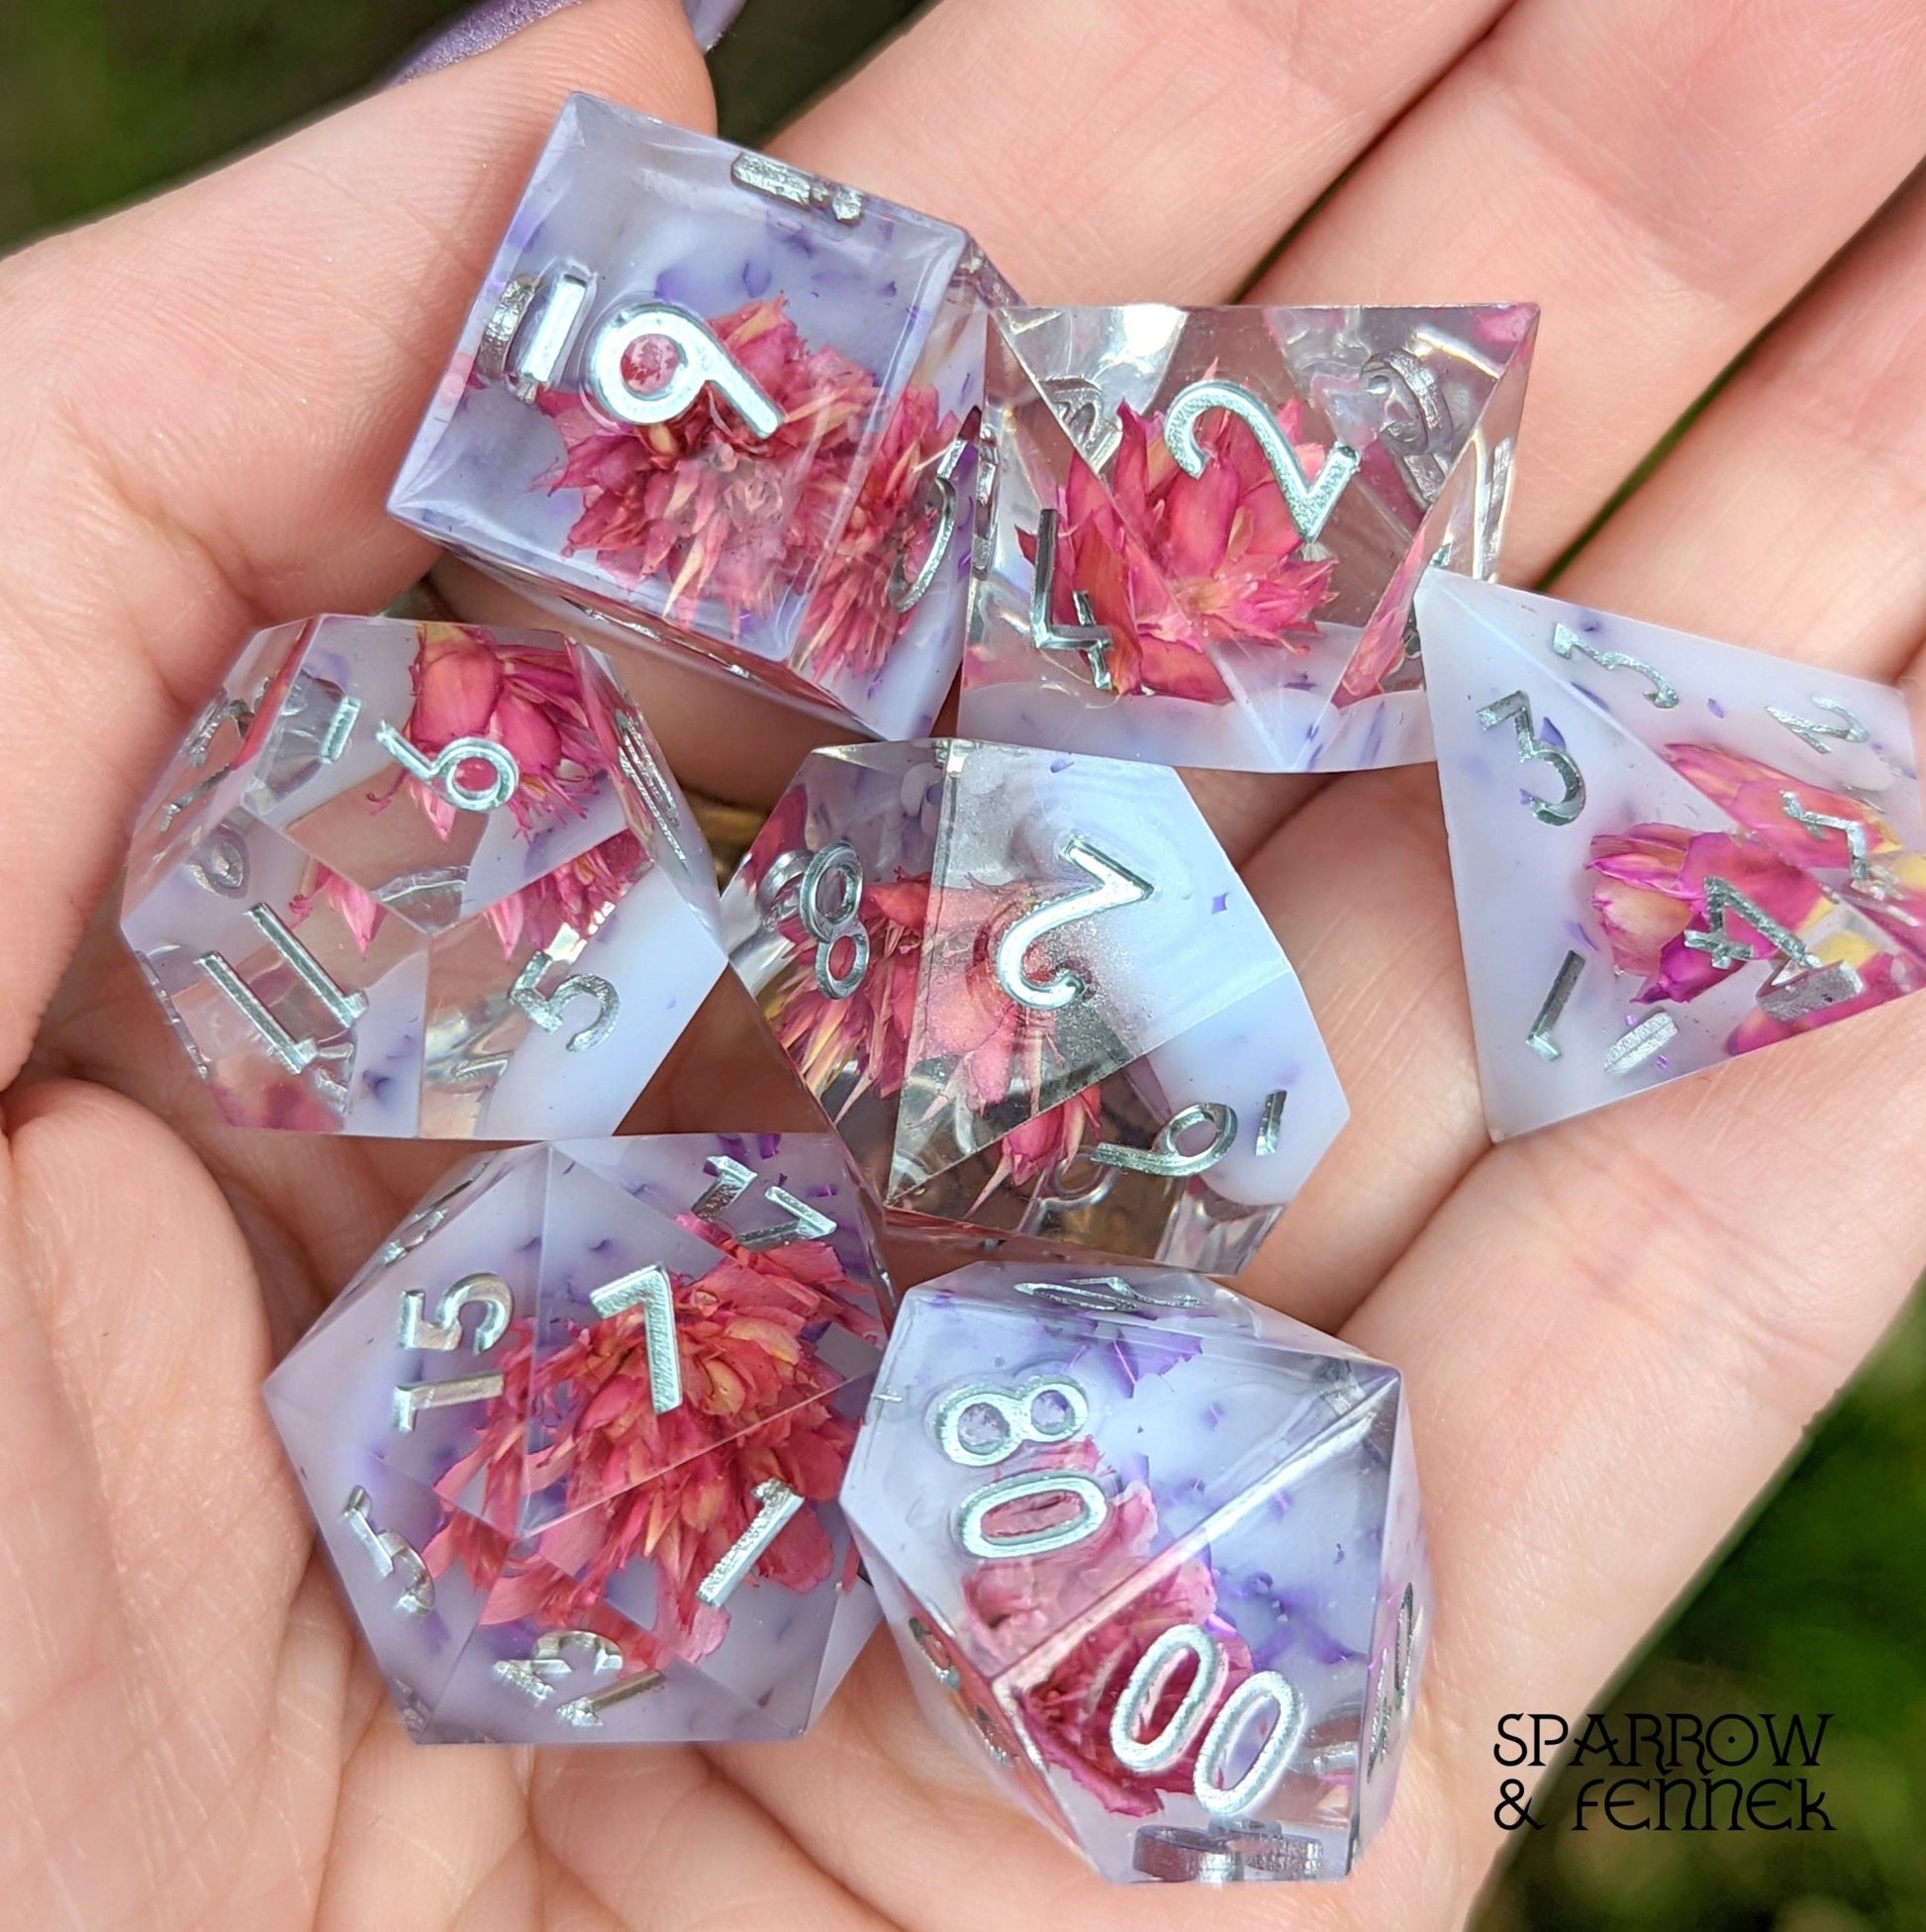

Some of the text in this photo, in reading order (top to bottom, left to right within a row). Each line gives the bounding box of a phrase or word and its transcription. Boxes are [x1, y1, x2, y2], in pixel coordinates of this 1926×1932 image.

[1164, 380, 1362, 544] 2
[1476, 690, 1586, 827] 3
[799, 840, 870, 1001] 8
[995, 835, 1156, 1012] 2
[1684, 875, 1823, 970] 4
[510, 945, 621, 1055] 5
[394, 1272, 515, 1433] 15
[589, 1263, 683, 1416] 7
[697, 1477, 805, 1608] 1
[1109, 1623, 1307, 1816] 00
